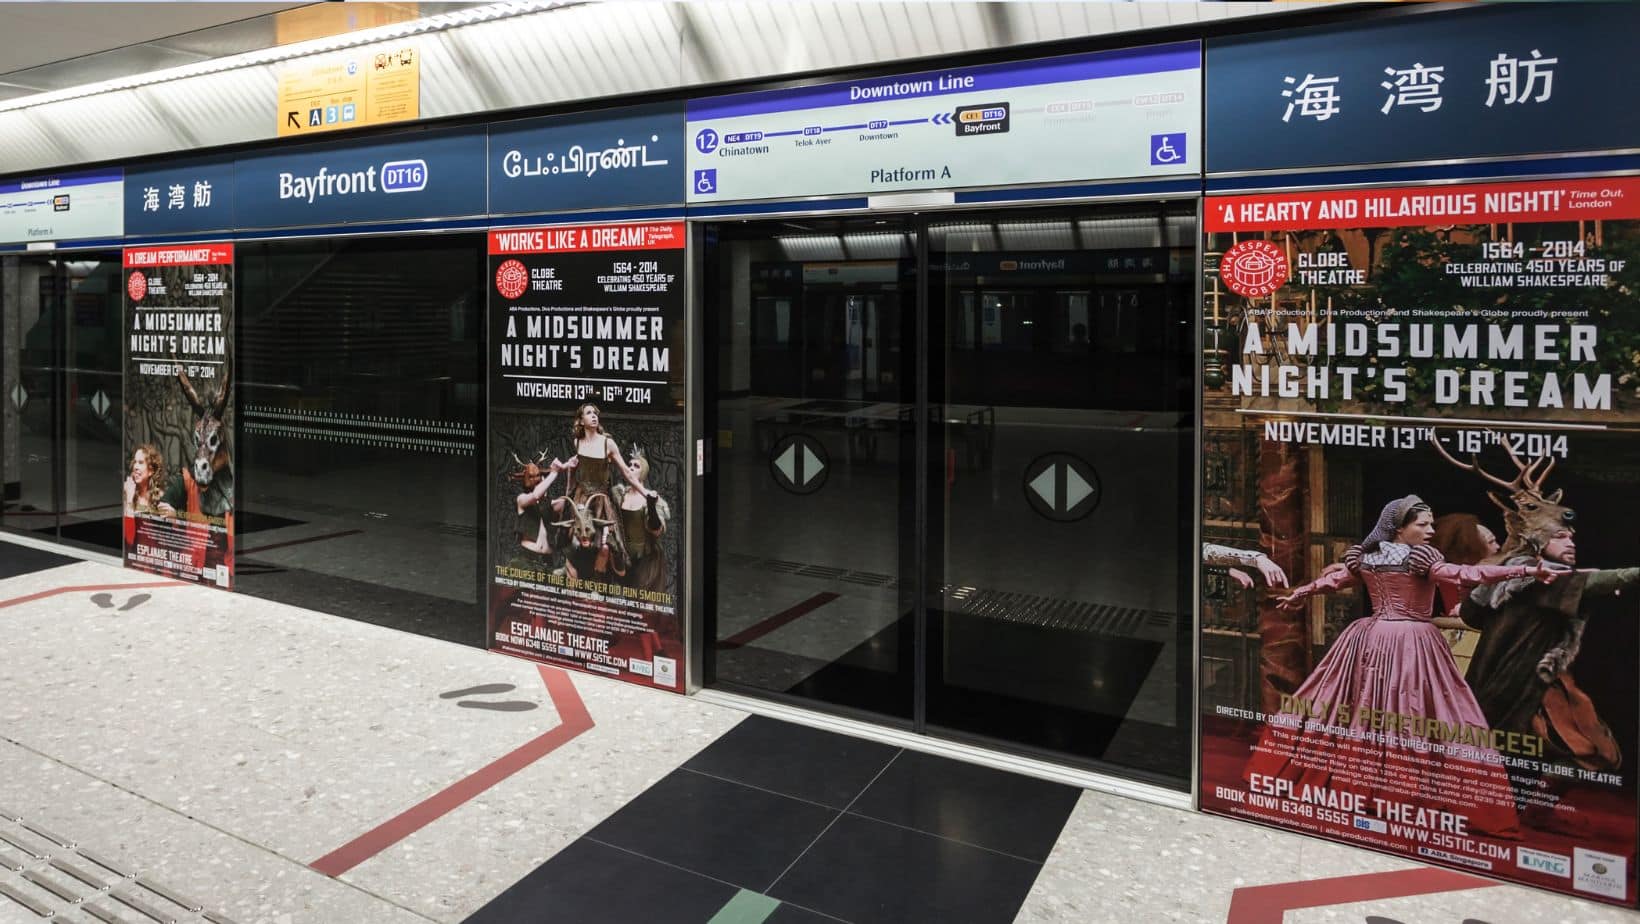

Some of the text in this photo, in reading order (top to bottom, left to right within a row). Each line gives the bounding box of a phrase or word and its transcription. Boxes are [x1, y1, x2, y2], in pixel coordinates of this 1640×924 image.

[850, 75, 975, 100] Downtown Line
[1281, 49, 1559, 123] 海湾舫
[311, 110, 320, 126] A
[327, 108, 336, 123] 3
[984, 110, 1003, 119] DT16
[805, 127, 821, 135] DT18
[870, 121, 887, 130] DT17
[964, 122, 1001, 133] Bayfront
[697, 134, 716, 150] 12
[727, 132, 762, 143] NE4 DT19
[795, 138, 832, 147] Telok Ayer
[859, 132, 899, 142] Downtown
[503, 135, 668, 178] பேஃபிரண்ட்
[719, 145, 769, 158] Chinatown
[871, 166, 952, 184] Platform A
[279, 167, 421, 204] Bayfront DT16
[143, 180, 212, 212] 海湾舫
[1569, 189, 1624, 200] Time Out,
[1240, 201, 1311, 223] HEARTY
[1318, 199, 1357, 220] AND
[1365, 194, 1476, 218] HILARIOUS
[1568, 198, 1612, 209] London
[548, 230, 576, 250] LIKE
[580, 229, 589, 249] A
[135, 251, 157, 264] DREAM
[1482, 240, 1585, 259] 1564 2014
[613, 261, 658, 274] 1564 2014
[1299, 252, 1348, 268] GLOBE
[1446, 258, 1626, 275] CELEBRATING 450 YEARS OF
[531, 268, 555, 279] GLOBE
[646, 273, 666, 283] YEARS
[1299, 270, 1366, 286] THEATRE
[1461, 273, 1609, 288] WILLIAM SHAKESPEARE
[531, 279, 563, 291] THEATRE
[628, 283, 668, 292] SHAKESPEARE
[1232, 283, 1276, 295] GLOBE
[1412, 309, 1478, 317] Shakespeare's
[1481, 309, 1509, 317] Globe
[1512, 309, 1548, 318] proudly
[1550, 310, 1589, 318] present
[134, 313, 222, 332] A MIDSUMMER
[506, 315, 663, 341] A MIDSUMMER
[131, 335, 225, 354] NIGHT'S DREAM
[1243, 322, 1598, 361] A MIDSUMMER
[501, 344, 669, 372] NIGHT'S DREAM
[140, 363, 172, 376] NOVEMBER
[200, 366, 215, 378] 2014
[516, 382, 651, 404] NOVEMBER 13TH 16TH 2014
[1232, 364, 1612, 410] NIGHT'S DREAM
[1264, 421, 1568, 459] NOVEMBER 13TH 16TH 2014
[496, 565, 508, 576] THE
[510, 567, 537, 580] COURSE
[537, 572, 546, 582] OF
[548, 574, 564, 586] TRUE
[566, 577, 583, 589] LOVE
[584, 580, 608, 593] NEVER
[609, 584, 620, 595] DID
[623, 586, 637, 598] RUN
[511, 621, 609, 654] ESPLANADE THEATRE
[574, 648, 628, 668] WWW.SISTIC.COM
[1280, 694, 1544, 757] ONLY 5 PERFORMANCES!
[1216, 705, 1254, 720] DIRECTED
[1256, 712, 1266, 721] BY
[1268, 715, 1302, 728] DOMINIC
[1360, 732, 1399, 745] ARTISTIC
[1401, 738, 1445, 754] DIRECTOR
[1448, 746, 1459, 756] OF
[1462, 748, 1539, 771] SHAKESPEARE'S
[1542, 763, 1575, 777] GLOBE
[1577, 769, 1623, 786] THEATRE
[1272, 730, 1289, 739] This
[1291, 735, 1335, 748] production
[1336, 742, 1350, 750] will
[1352, 746, 1383, 758] employ
[1385, 751, 1442, 767] Renaissance
[1444, 763, 1488, 776] costumes
[1490, 771, 1509, 780] and
[1520, 788, 1560, 801] bookings
[1249, 772, 1469, 836] ESPLANADE THEATRE
[1216, 786, 1246, 803] BOOK
[1248, 793, 1279, 810] NOW!
[1281, 800, 1313, 818] 6348
[1316, 808, 1349, 826] 5555
[1390, 823, 1511, 861] WWW.SISTIC.COM
[1431, 850, 1448, 858] ABA
